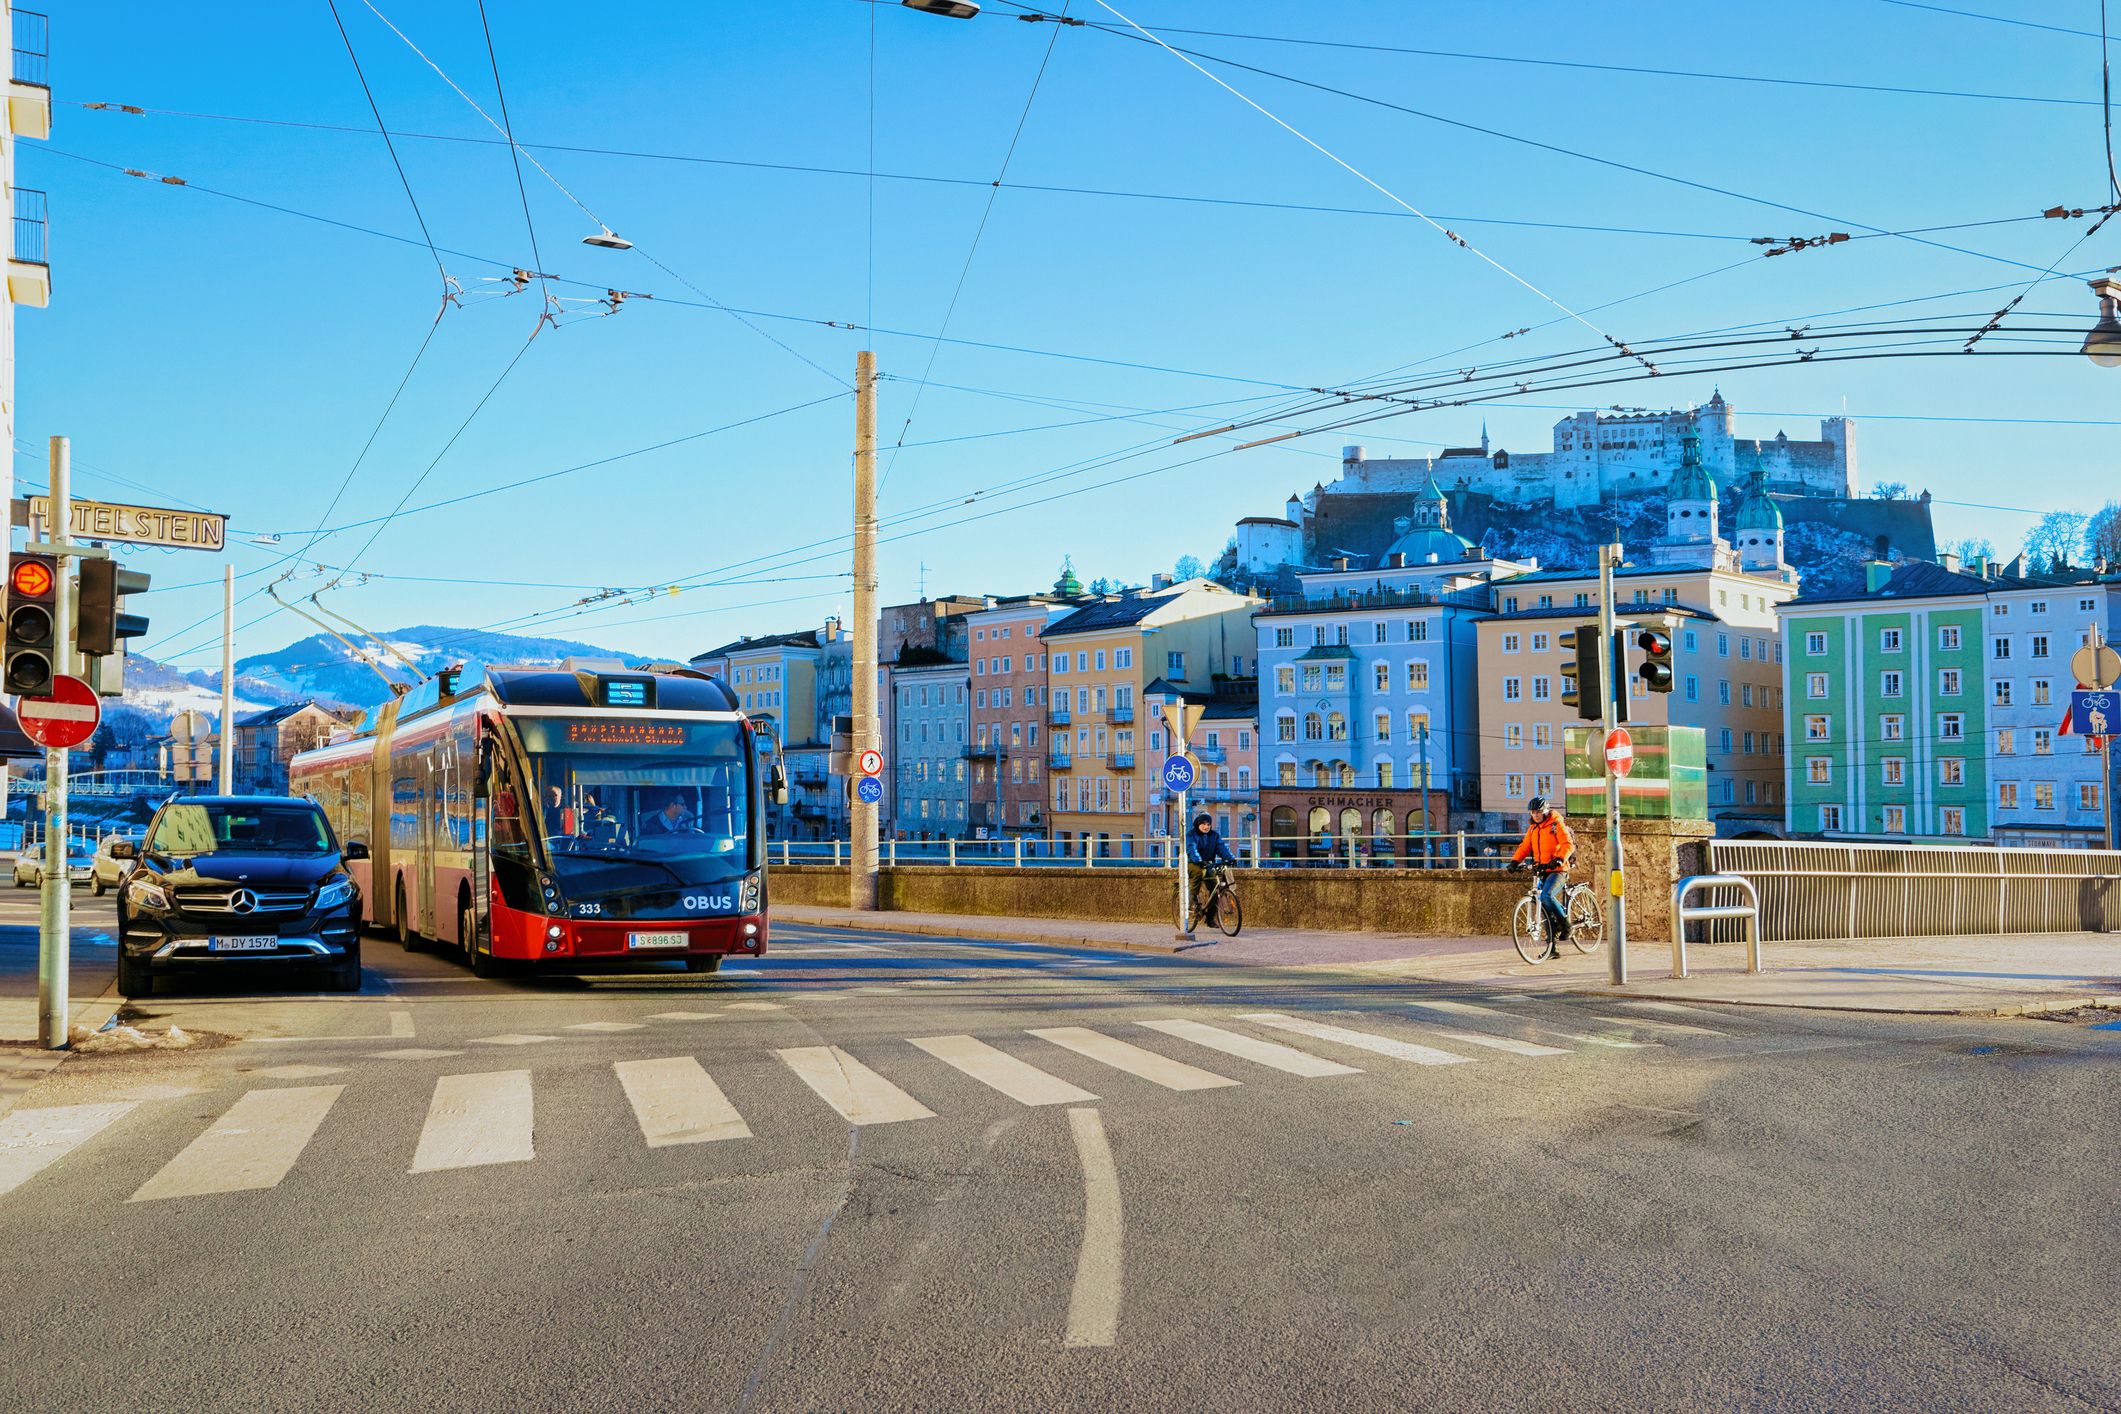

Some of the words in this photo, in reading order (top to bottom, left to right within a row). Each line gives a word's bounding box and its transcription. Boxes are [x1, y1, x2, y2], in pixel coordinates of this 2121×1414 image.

[33, 500, 127, 535] HTEL
[134, 510, 221, 544] STEIN
[1308, 797, 1393, 807] GEHMACHER
[683, 896, 732, 910] OBUS
[579, 904, 601, 915] 333
[216, 939, 224, 948] M
[248, 938, 276, 948] 1578
